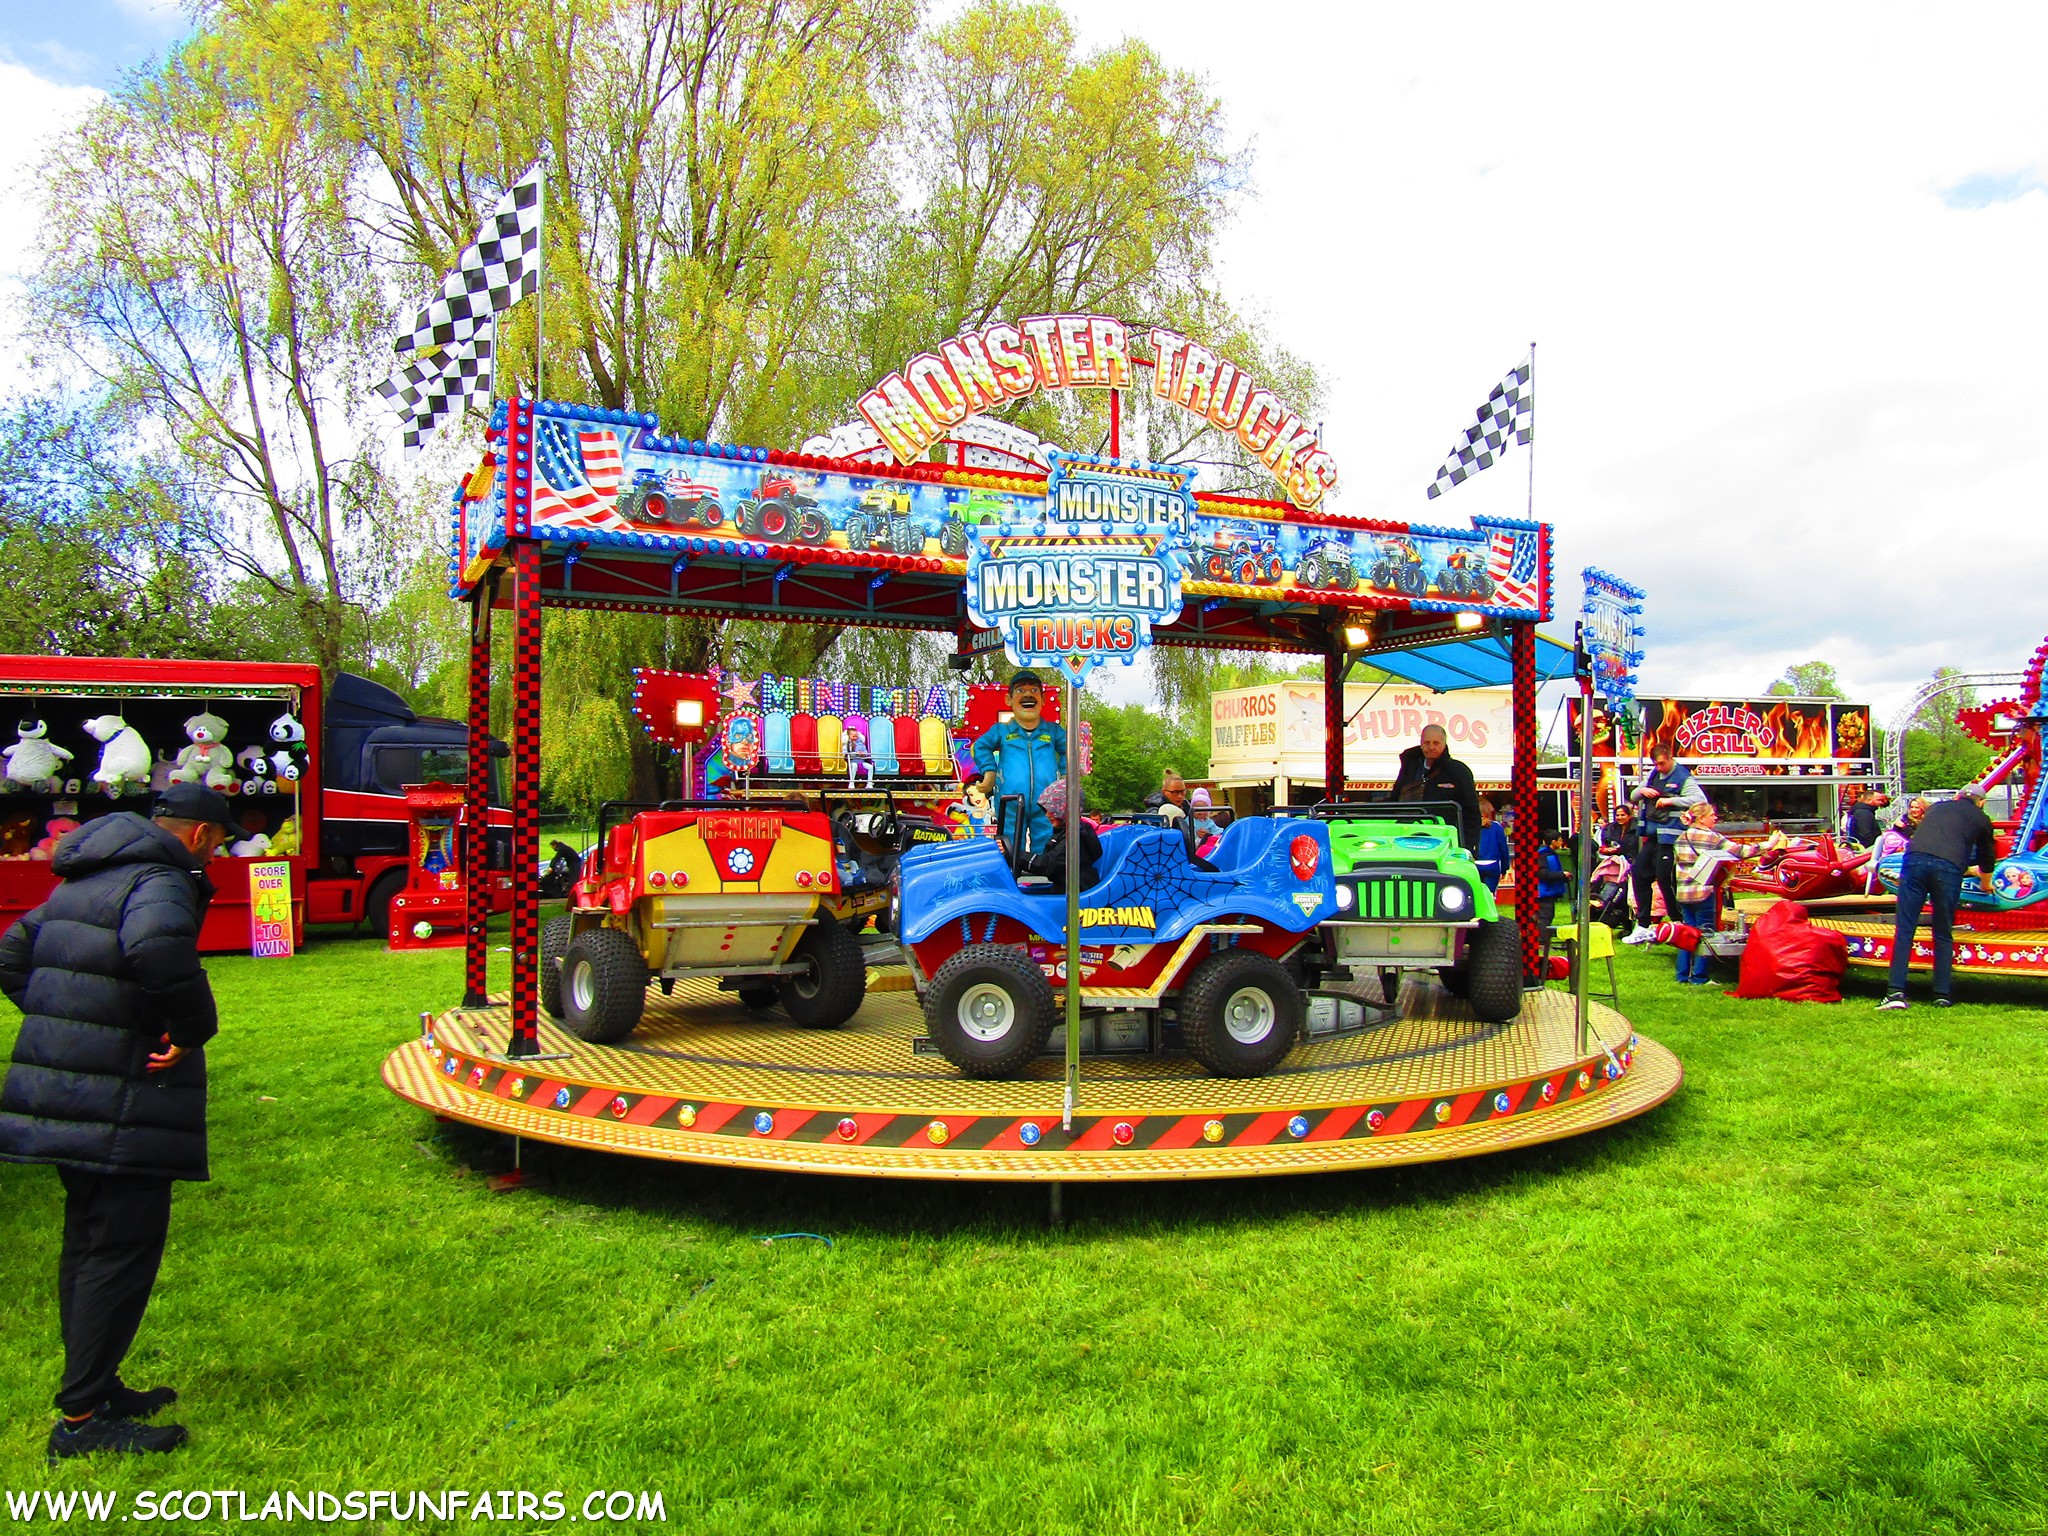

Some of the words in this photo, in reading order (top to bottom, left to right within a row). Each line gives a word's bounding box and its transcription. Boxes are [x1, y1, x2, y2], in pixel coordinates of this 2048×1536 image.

[858, 315, 1132, 466] MONSTER
[1150, 327, 1338, 511] TRUCKS
[1058, 482, 1187, 535] MONSTER
[983, 560, 1168, 612] MONSTER
[1018, 617, 1134, 651] TRUCKS
[761, 672, 861, 717] MINI
[1394, 692, 1432, 706] mr.
[1214, 693, 1277, 721] CHURROS
[1214, 721, 1277, 748] WAFFLES
[1675, 705, 1775, 749] SIZZLERS
[1696, 732, 1757, 754] GRILL
[1697, 765, 1737, 775] SIZZLERS
[1738, 765, 1763, 775] GRILL
[1542, 782, 1577, 790] CREPES
[697, 817, 742, 839] IRON
[743, 817, 782, 839] MAN
[913, 829, 948, 842] BATMAN
[254, 866, 286, 877] SCORE
[258, 878, 283, 889] OVER
[255, 893, 288, 922] 45
[261, 923, 282, 939] TO
[257, 940, 290, 956] WIN
